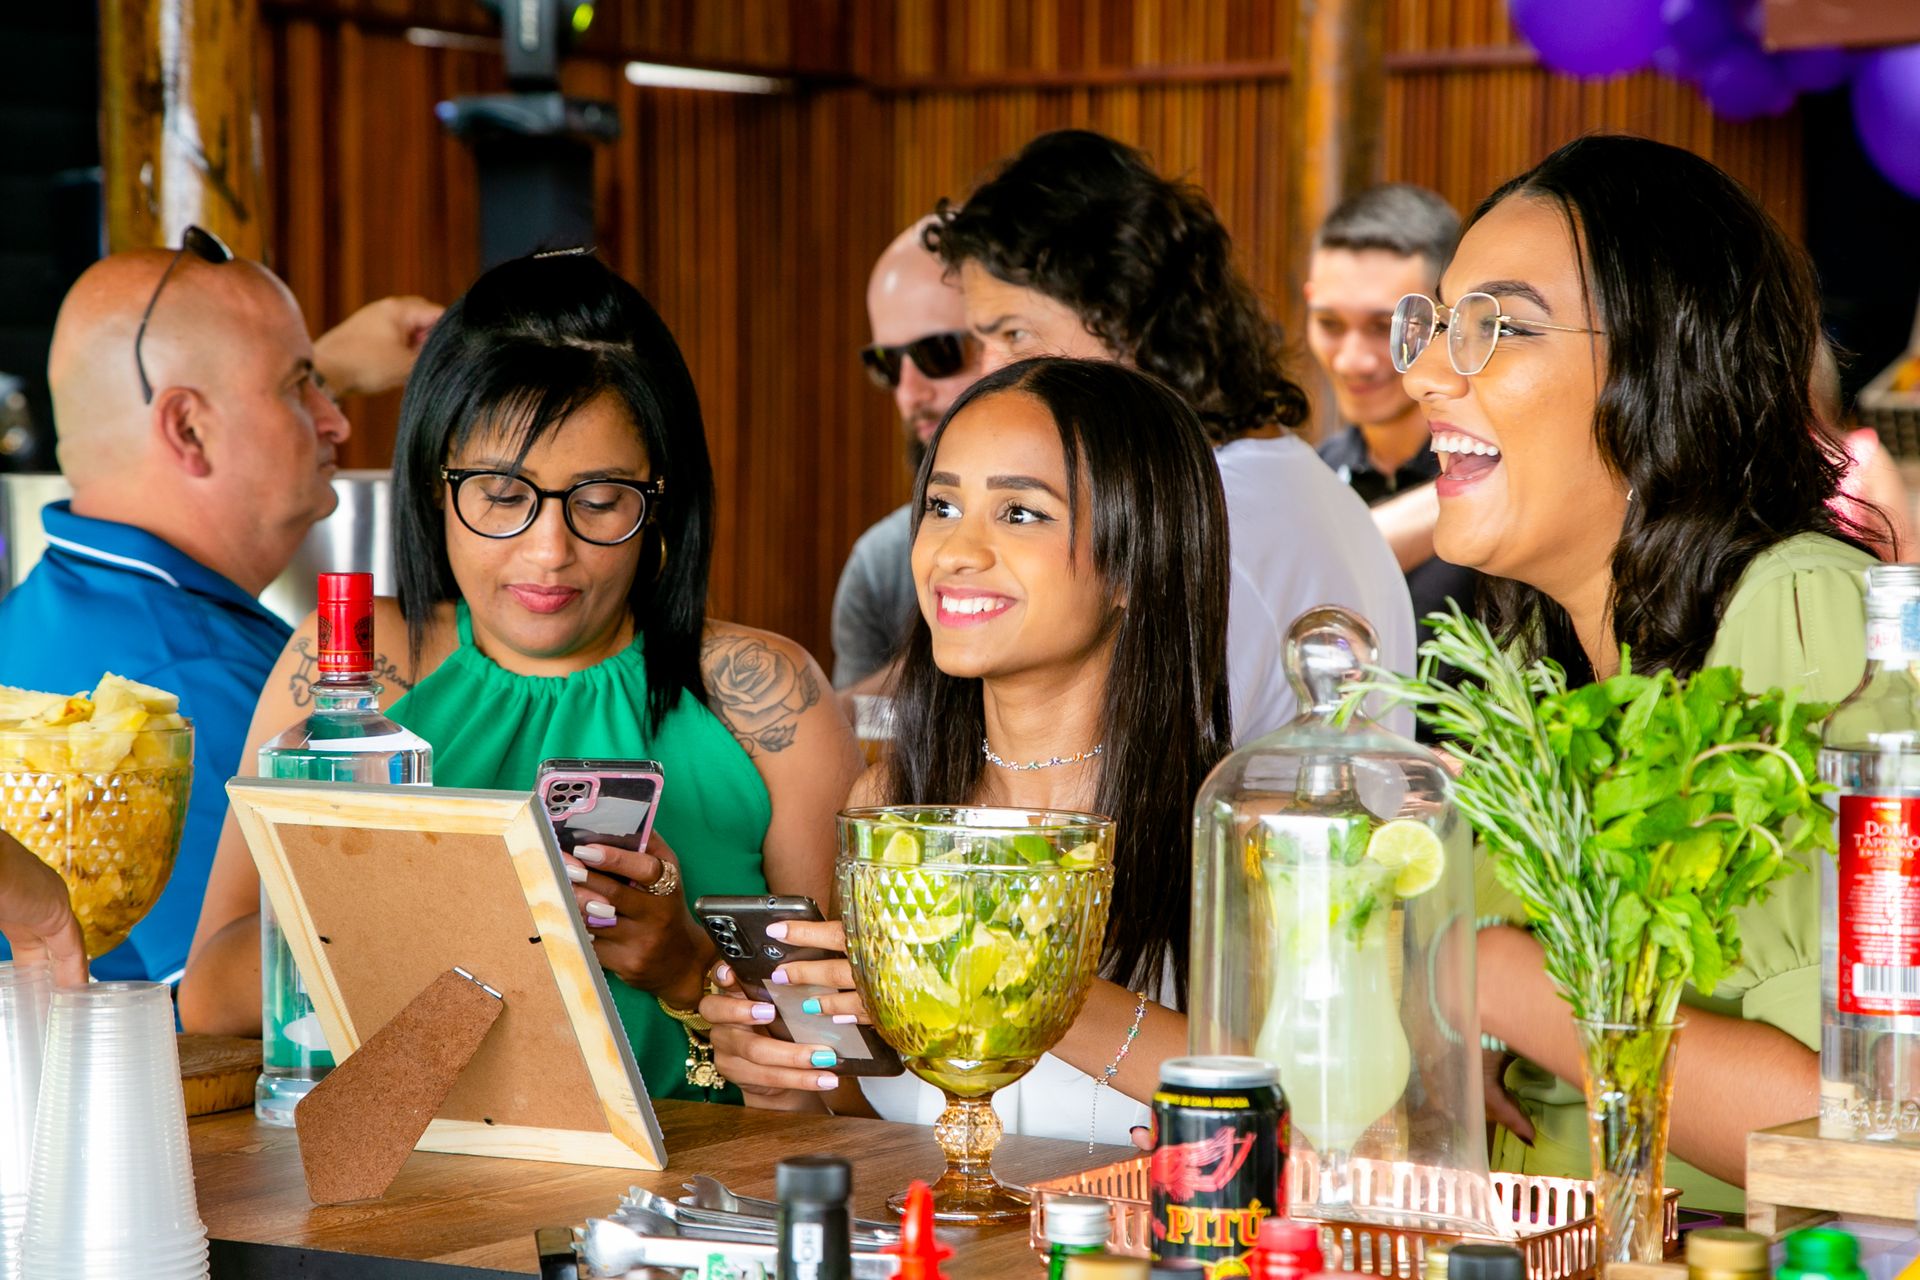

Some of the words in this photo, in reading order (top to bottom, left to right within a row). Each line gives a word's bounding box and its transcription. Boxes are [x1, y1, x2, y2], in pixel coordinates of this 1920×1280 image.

[1864, 820, 1909, 837] DOM
[1853, 833, 1920, 850] TAPPARO
[1166, 1199, 1265, 1246] PITÚ
